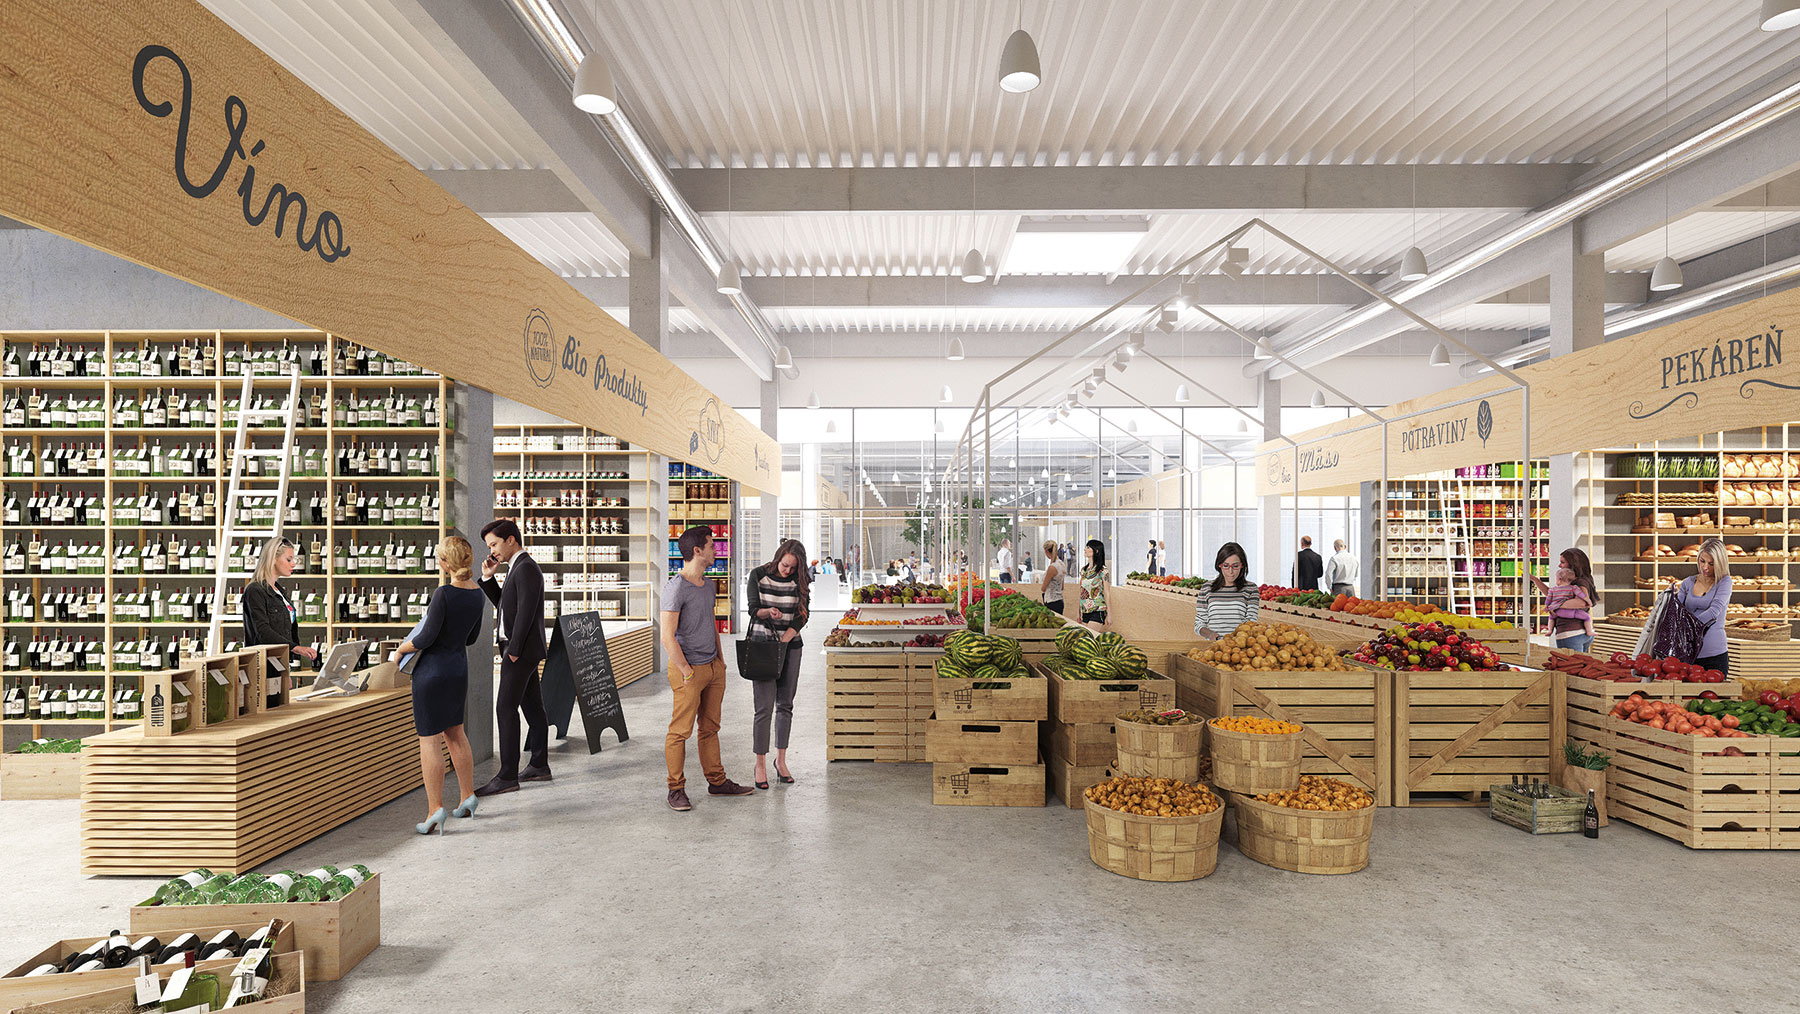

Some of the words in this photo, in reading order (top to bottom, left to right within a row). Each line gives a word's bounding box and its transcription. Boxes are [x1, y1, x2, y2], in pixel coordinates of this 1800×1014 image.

[132, 44, 351, 263] Víno
[562, 335, 587, 378] Bio
[594, 354, 648, 417] Produkty
[1660, 324, 1784, 390] PEKÁREŇ
[1300, 447, 1339, 473] Mäso
[1402, 417, 1468, 453] POTRAVINY
